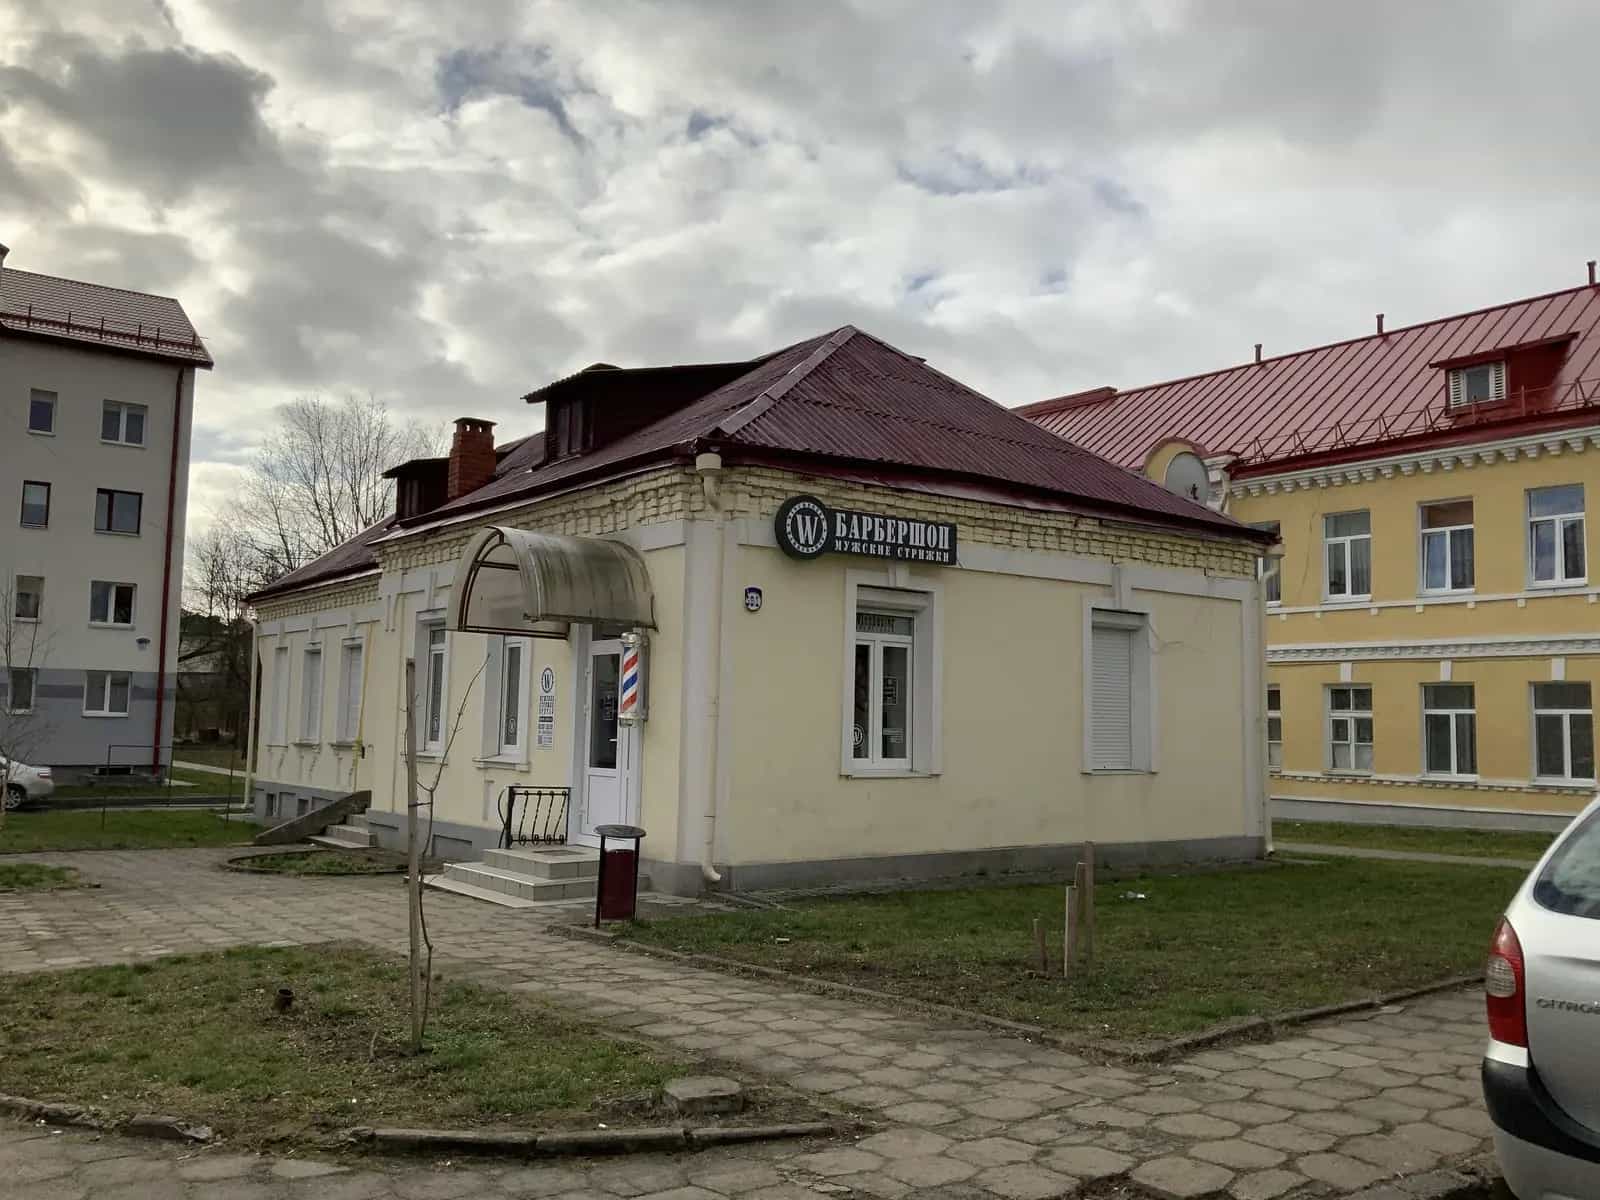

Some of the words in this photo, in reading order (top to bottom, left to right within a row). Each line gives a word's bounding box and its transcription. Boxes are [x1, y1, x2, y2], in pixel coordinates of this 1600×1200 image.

[795, 513, 819, 546] W
[835, 512, 950, 550] БАРБЕРШОП
[834, 539, 891, 557] МУЖСКИЕ
[897, 546, 950, 563] СТРИЖКИ
